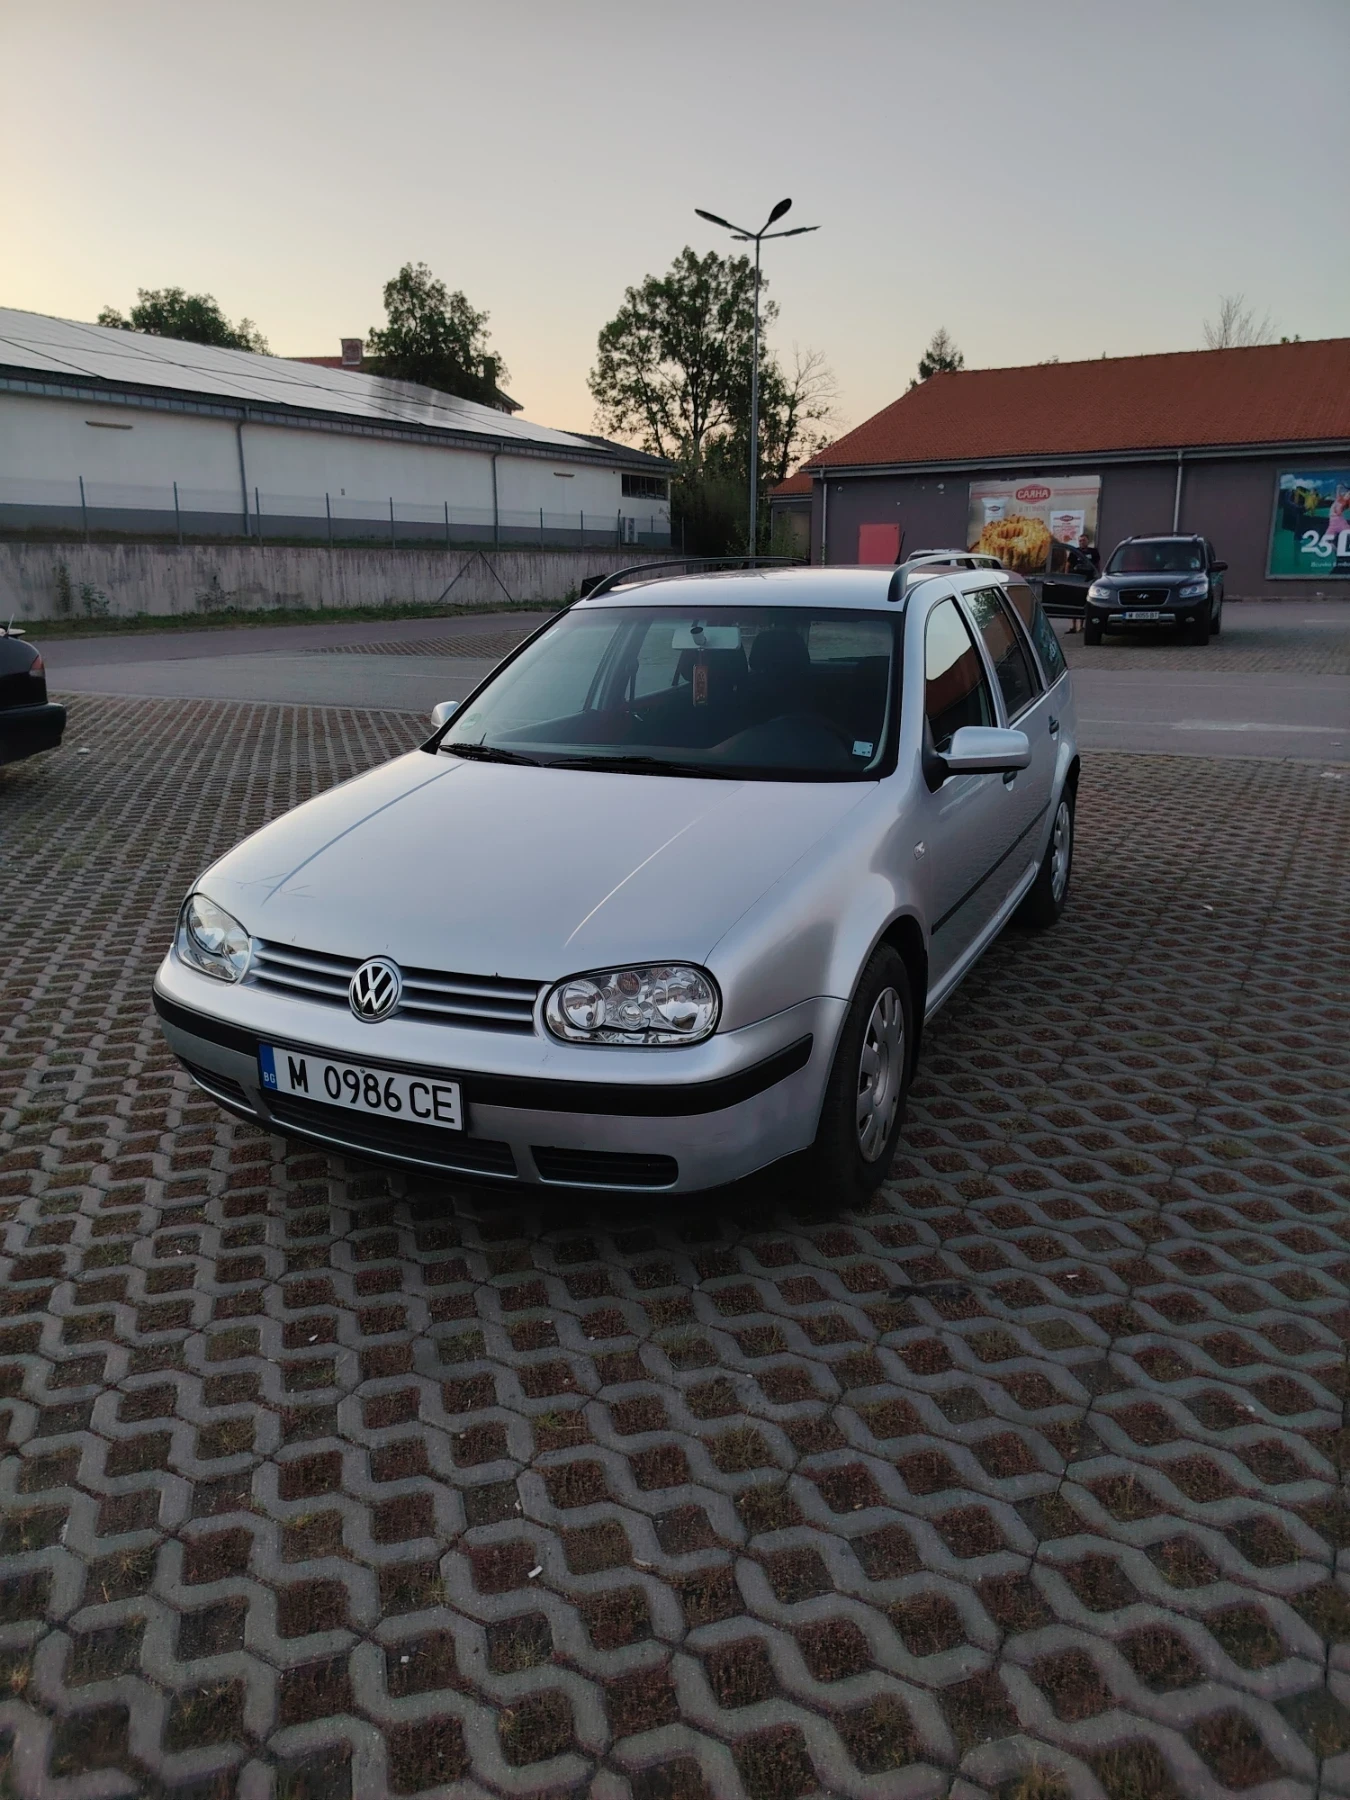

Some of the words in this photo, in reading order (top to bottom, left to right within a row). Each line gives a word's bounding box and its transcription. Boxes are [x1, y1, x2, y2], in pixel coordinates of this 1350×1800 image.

[1017, 487, 1049, 499] САЯНА
[263, 1071, 276, 1084] BG
[288, 1055, 309, 1093] M
[323, 1065, 402, 1113] 0986
[409, 1082, 455, 1124] CE
